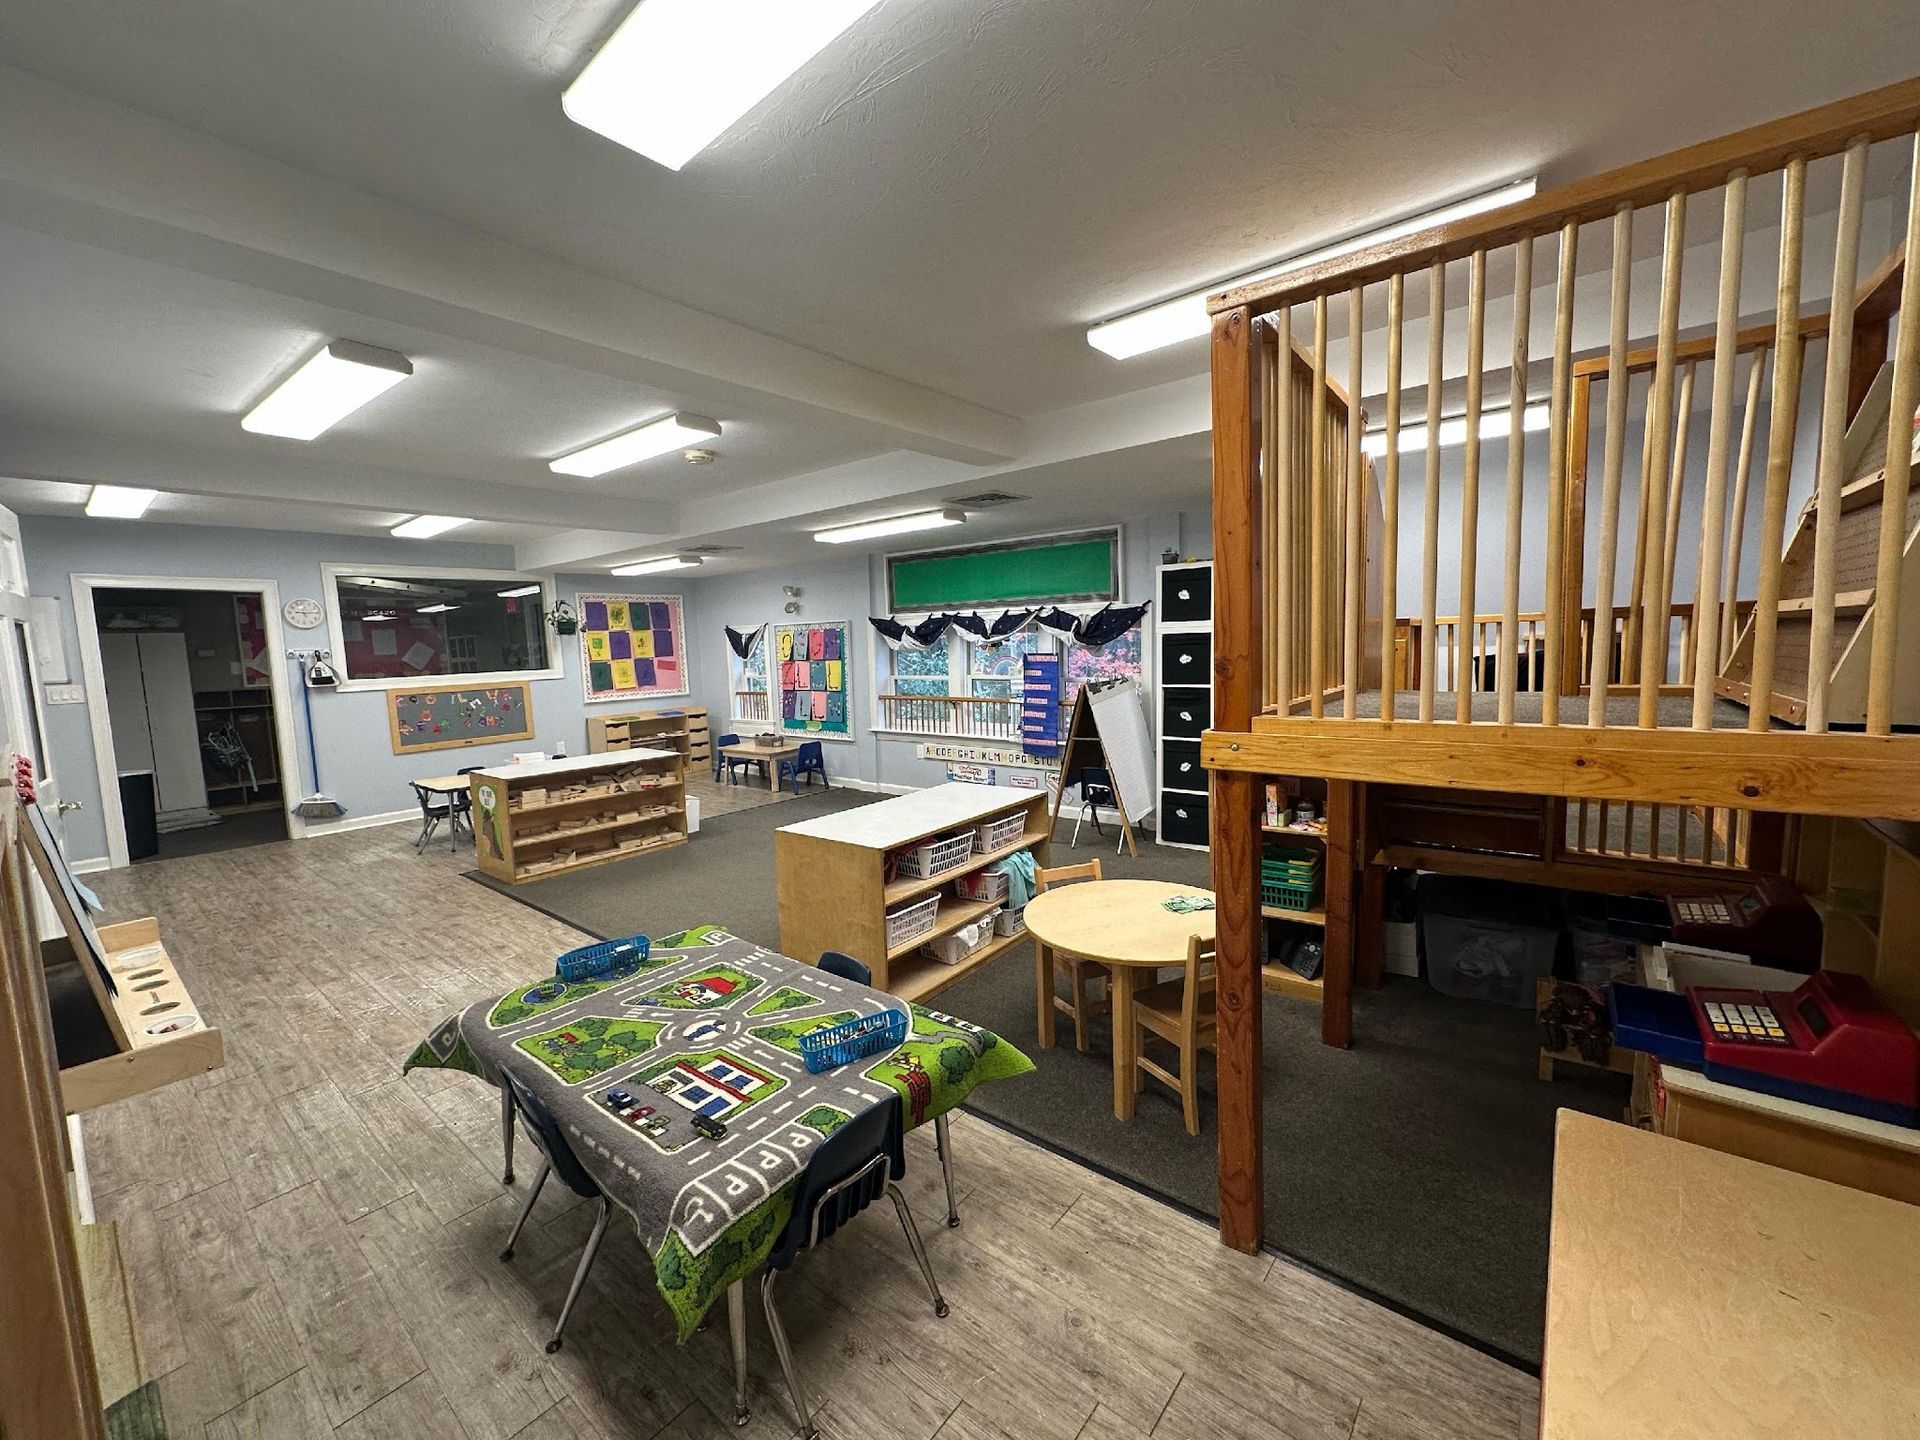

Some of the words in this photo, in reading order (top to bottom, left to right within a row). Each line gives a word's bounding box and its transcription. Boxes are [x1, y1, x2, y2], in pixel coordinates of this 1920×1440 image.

[789, 1132, 812, 1147] P
[759, 1150, 783, 1169] P
[725, 1174, 749, 1195] P
